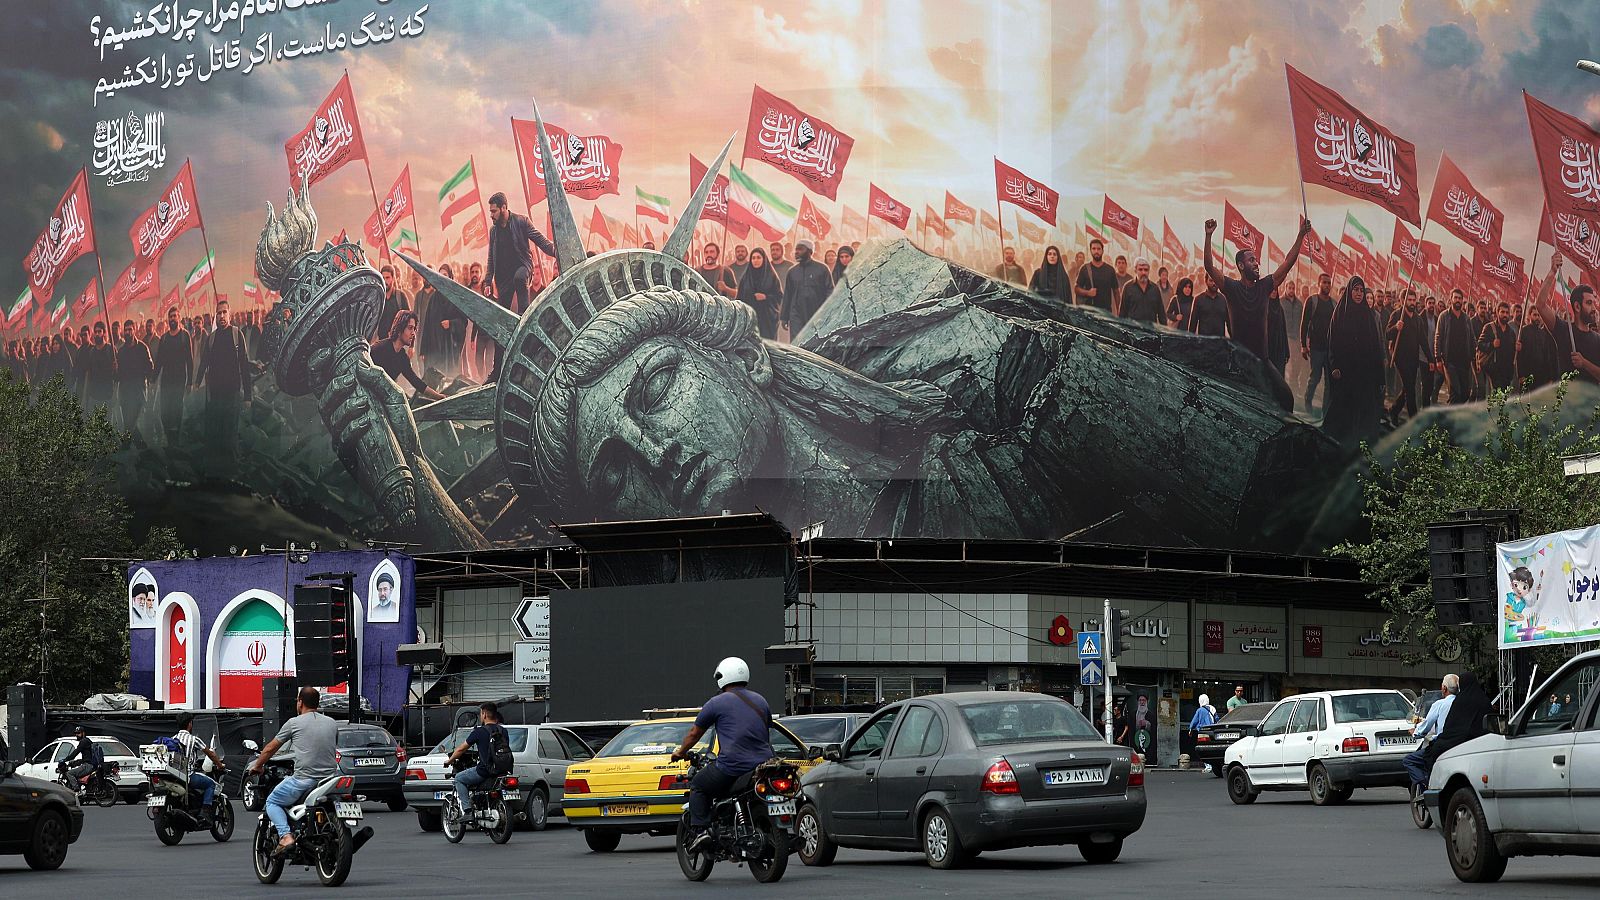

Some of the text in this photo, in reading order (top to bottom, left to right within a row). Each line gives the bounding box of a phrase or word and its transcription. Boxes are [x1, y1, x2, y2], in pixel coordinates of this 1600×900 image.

[351, 11, 395, 46] ننگ
[400, 4, 429, 36] که
[160, 52, 173, 89] را
[174, 53, 194, 87] تو
[198, 40, 241, 82] قاتل
[241, 32, 274, 74] اگر
[93, 56, 158, 108] نکشیم
[1241, 637, 1279, 653] ساعتی
